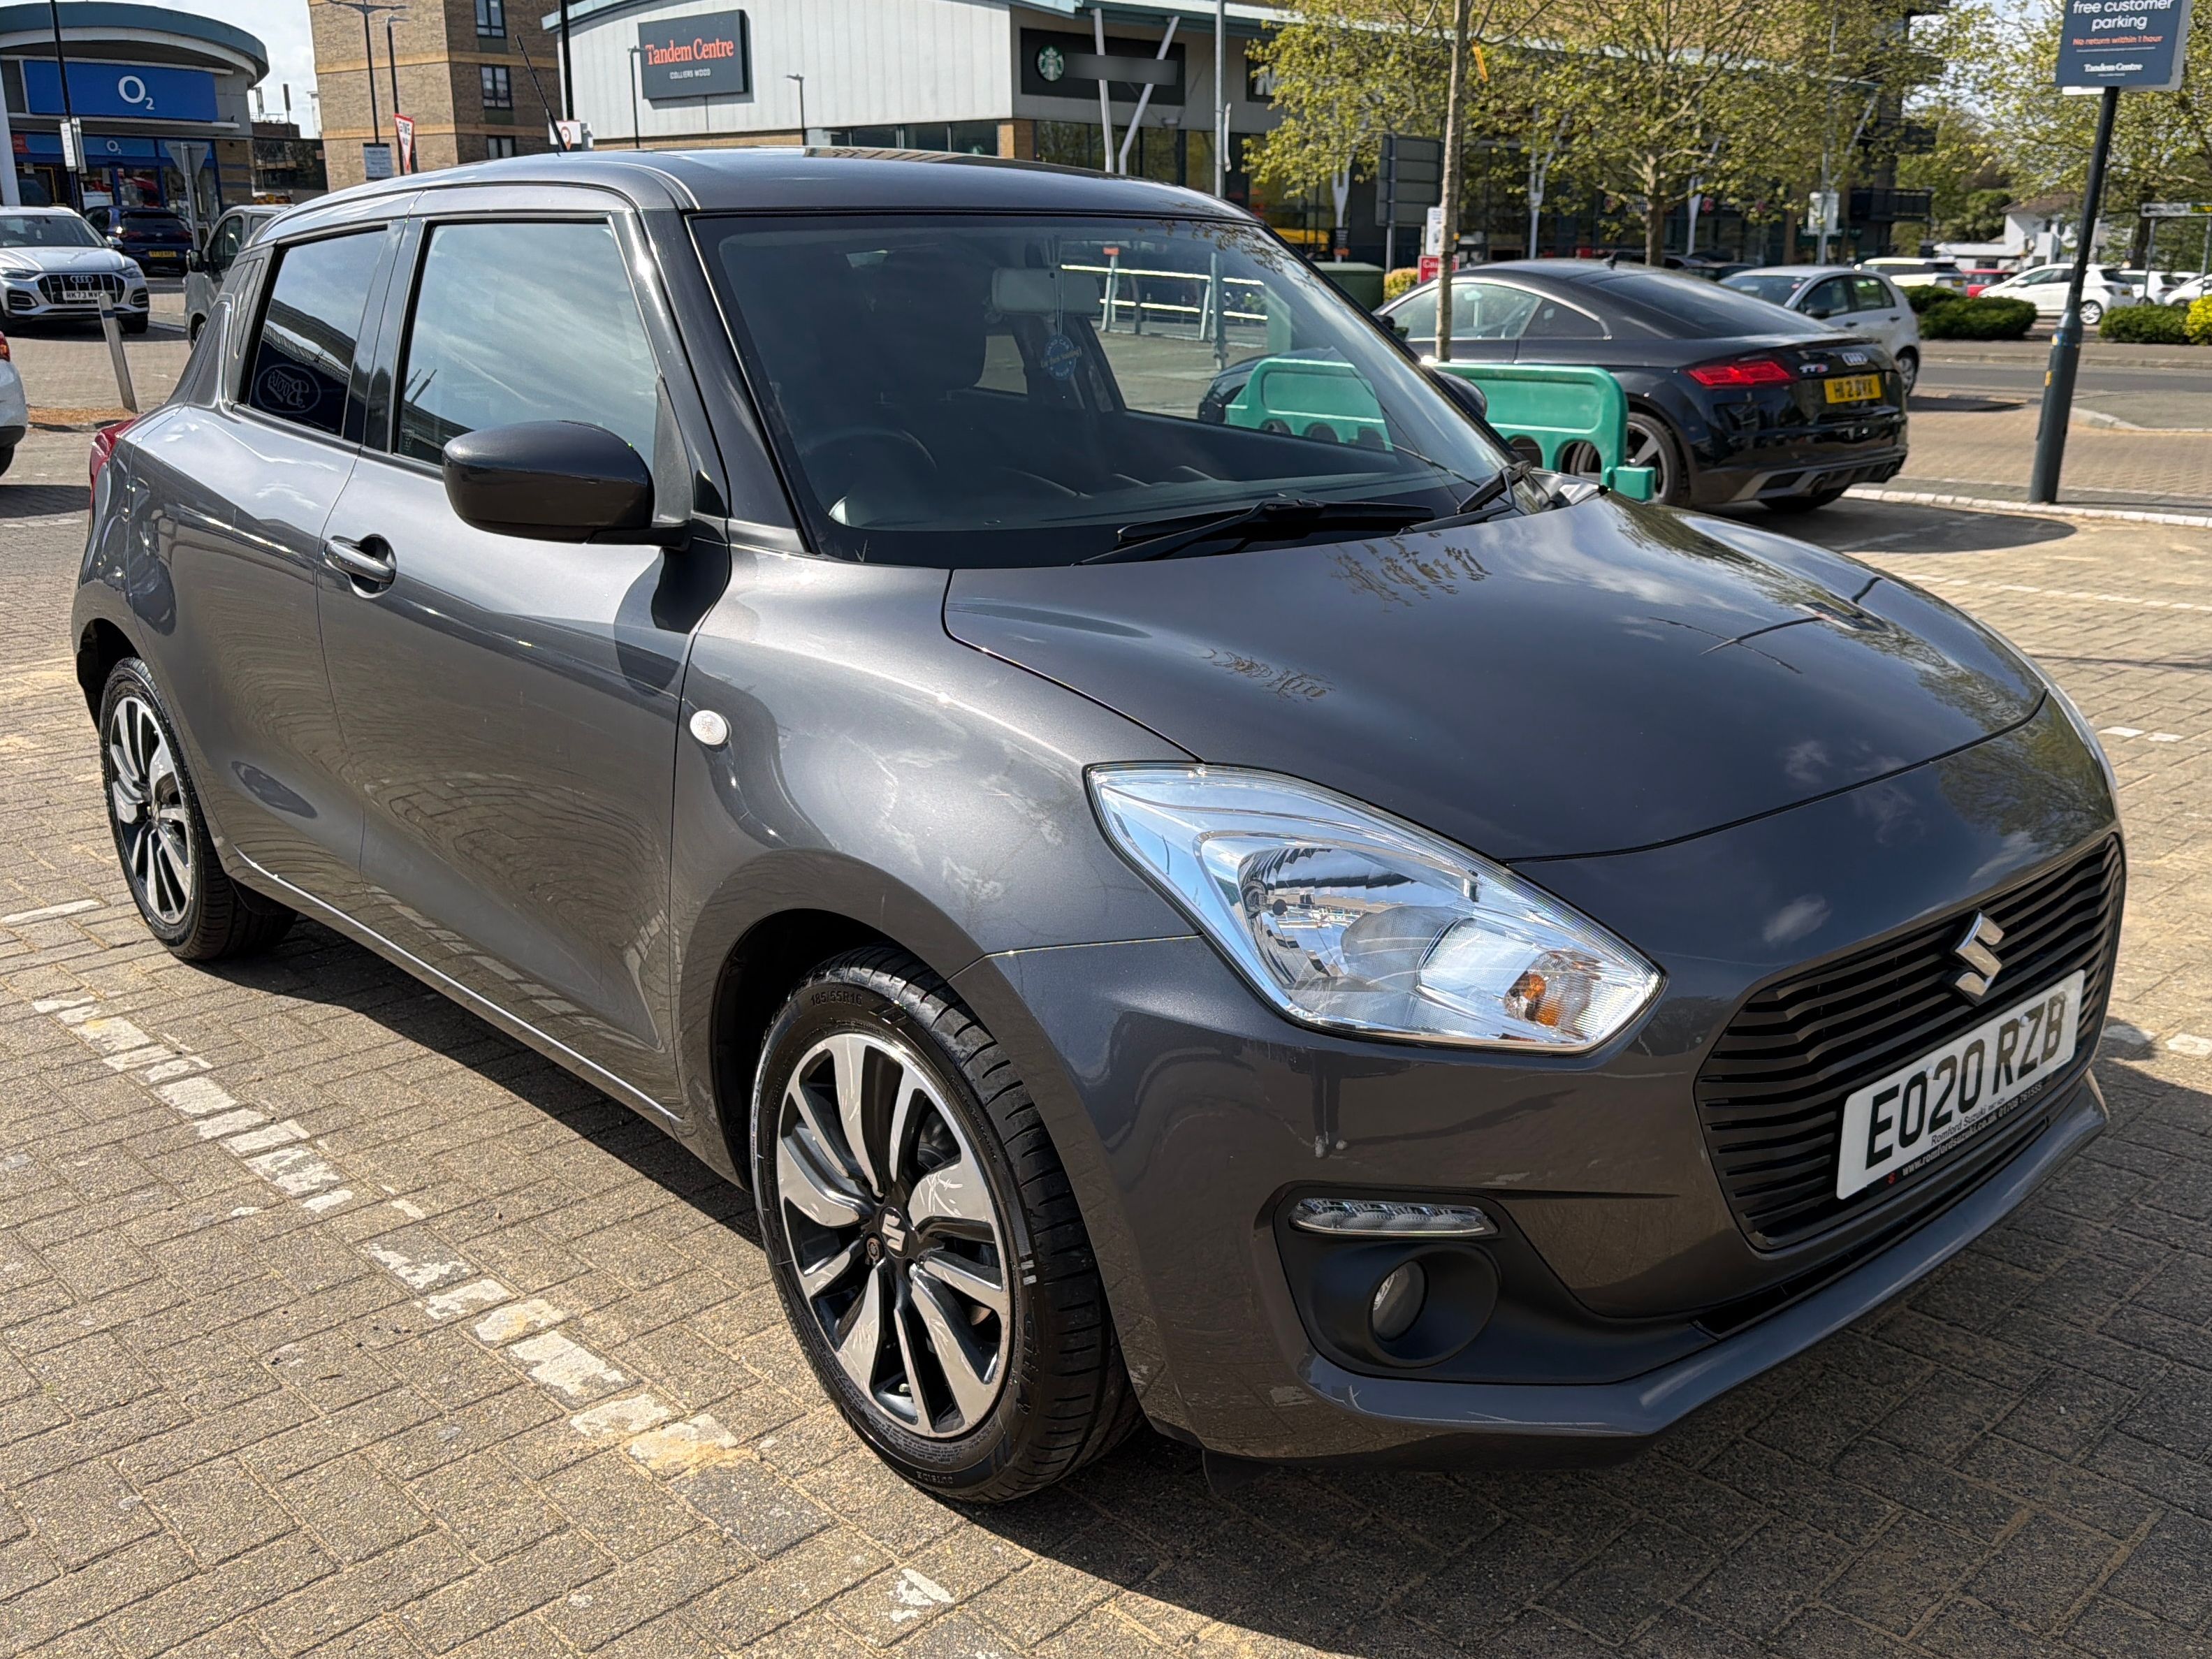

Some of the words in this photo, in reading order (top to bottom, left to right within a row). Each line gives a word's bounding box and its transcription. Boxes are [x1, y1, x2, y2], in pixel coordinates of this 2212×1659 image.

[2072, 1, 2102, 14] free
[2104, 0, 2174, 13] customer
[2091, 15, 2148, 32] parking
[645, 39, 693, 65] Tandem
[693, 37, 734, 60] Centre
[2083, 62, 2116, 73] Tandem
[2115, 62, 2144, 71] Centre
[1992, 991, 2066, 1095] RZB
[1931, 1119, 1963, 1146] Romford
[1963, 1104, 1987, 1127] Suzuki
